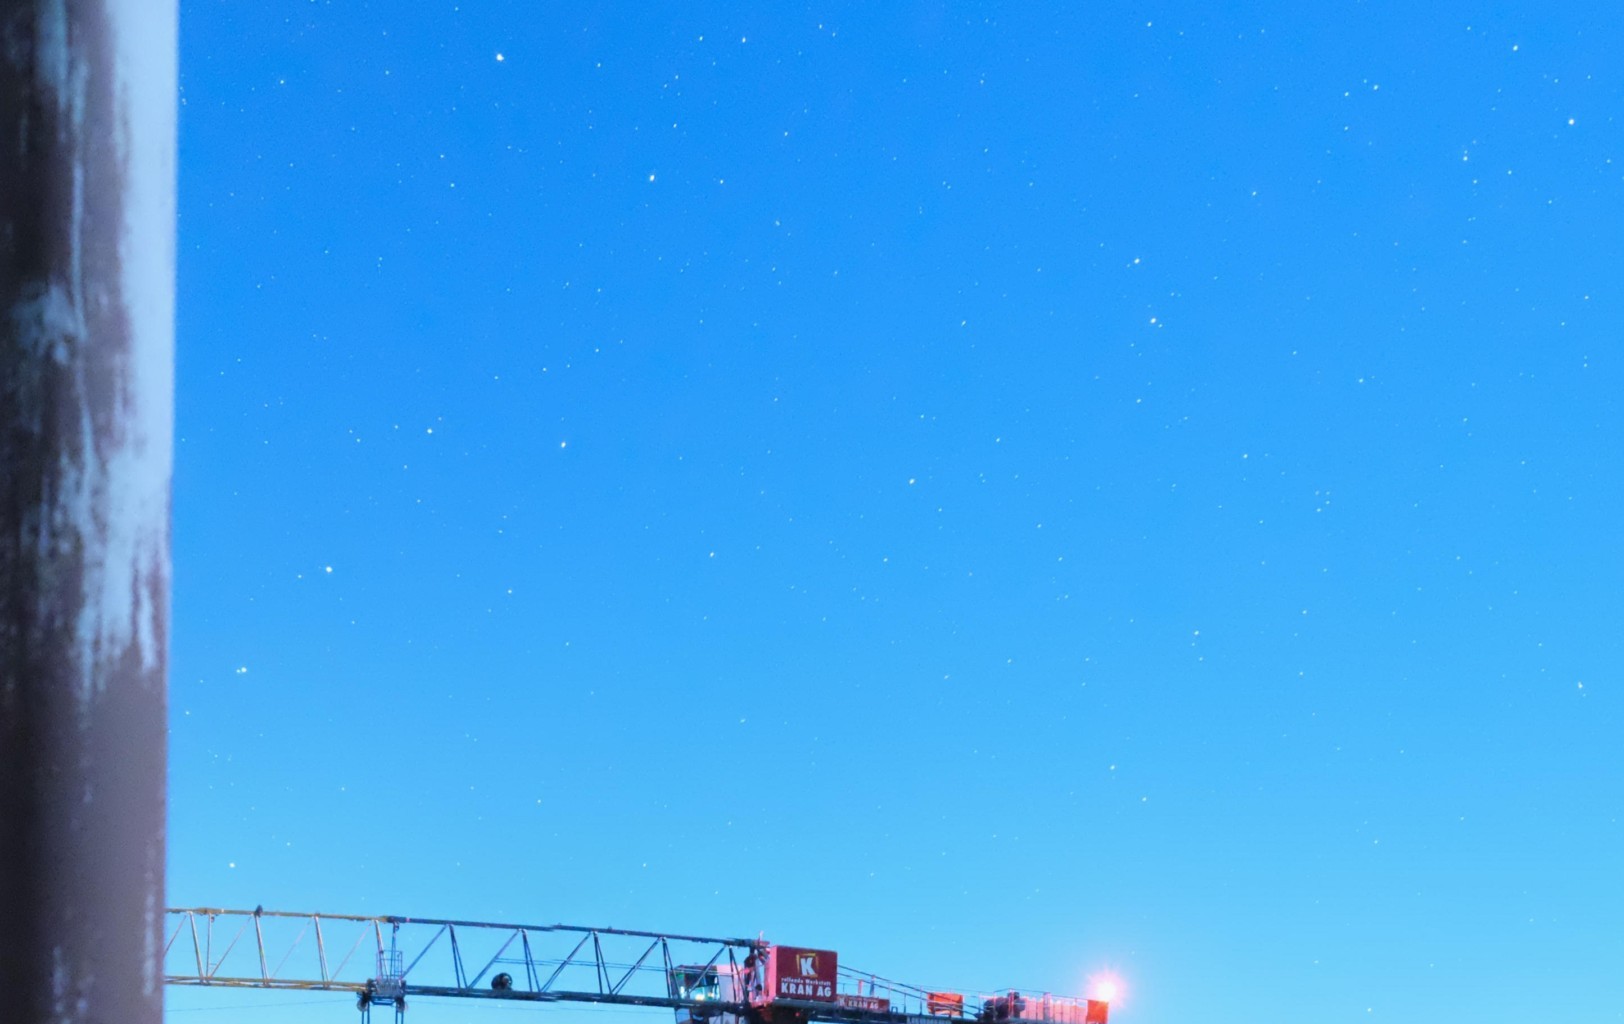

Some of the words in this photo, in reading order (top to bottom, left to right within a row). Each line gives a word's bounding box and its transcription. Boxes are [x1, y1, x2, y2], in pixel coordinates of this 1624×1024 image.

[800, 957, 816, 976] K
[781, 982, 813, 996] KRAN
[816, 986, 832, 998] AG
[848, 1000, 868, 1009] KRAN
